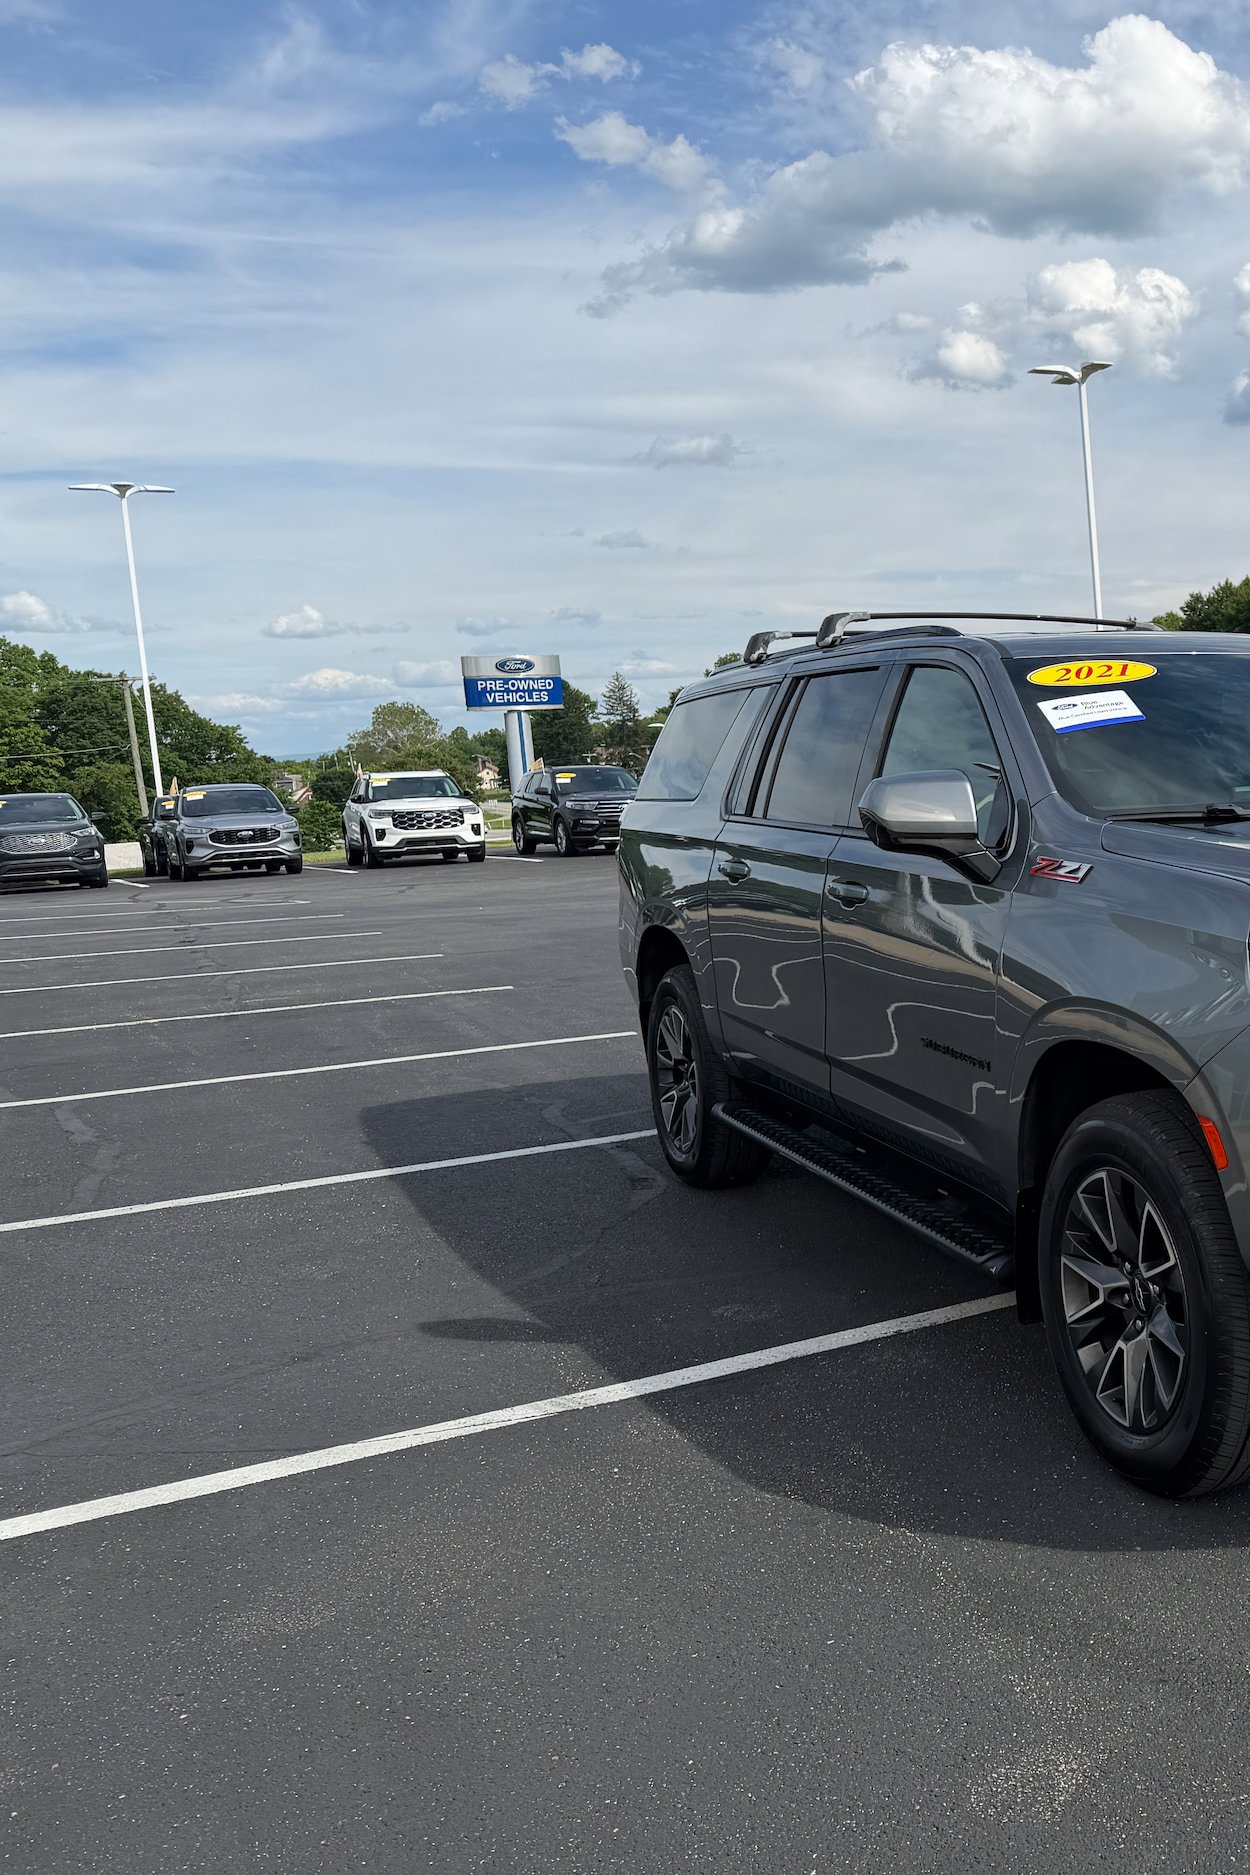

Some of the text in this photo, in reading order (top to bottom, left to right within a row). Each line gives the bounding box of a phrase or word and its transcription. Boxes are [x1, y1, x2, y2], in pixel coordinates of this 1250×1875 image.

[504, 660, 526, 670] Ford
[1054, 663, 1130, 683] 2021
[477, 679, 554, 691] PRE-OWNED
[486, 691, 549, 703] VEHICLES
[1029, 856, 1094, 884] Z71
